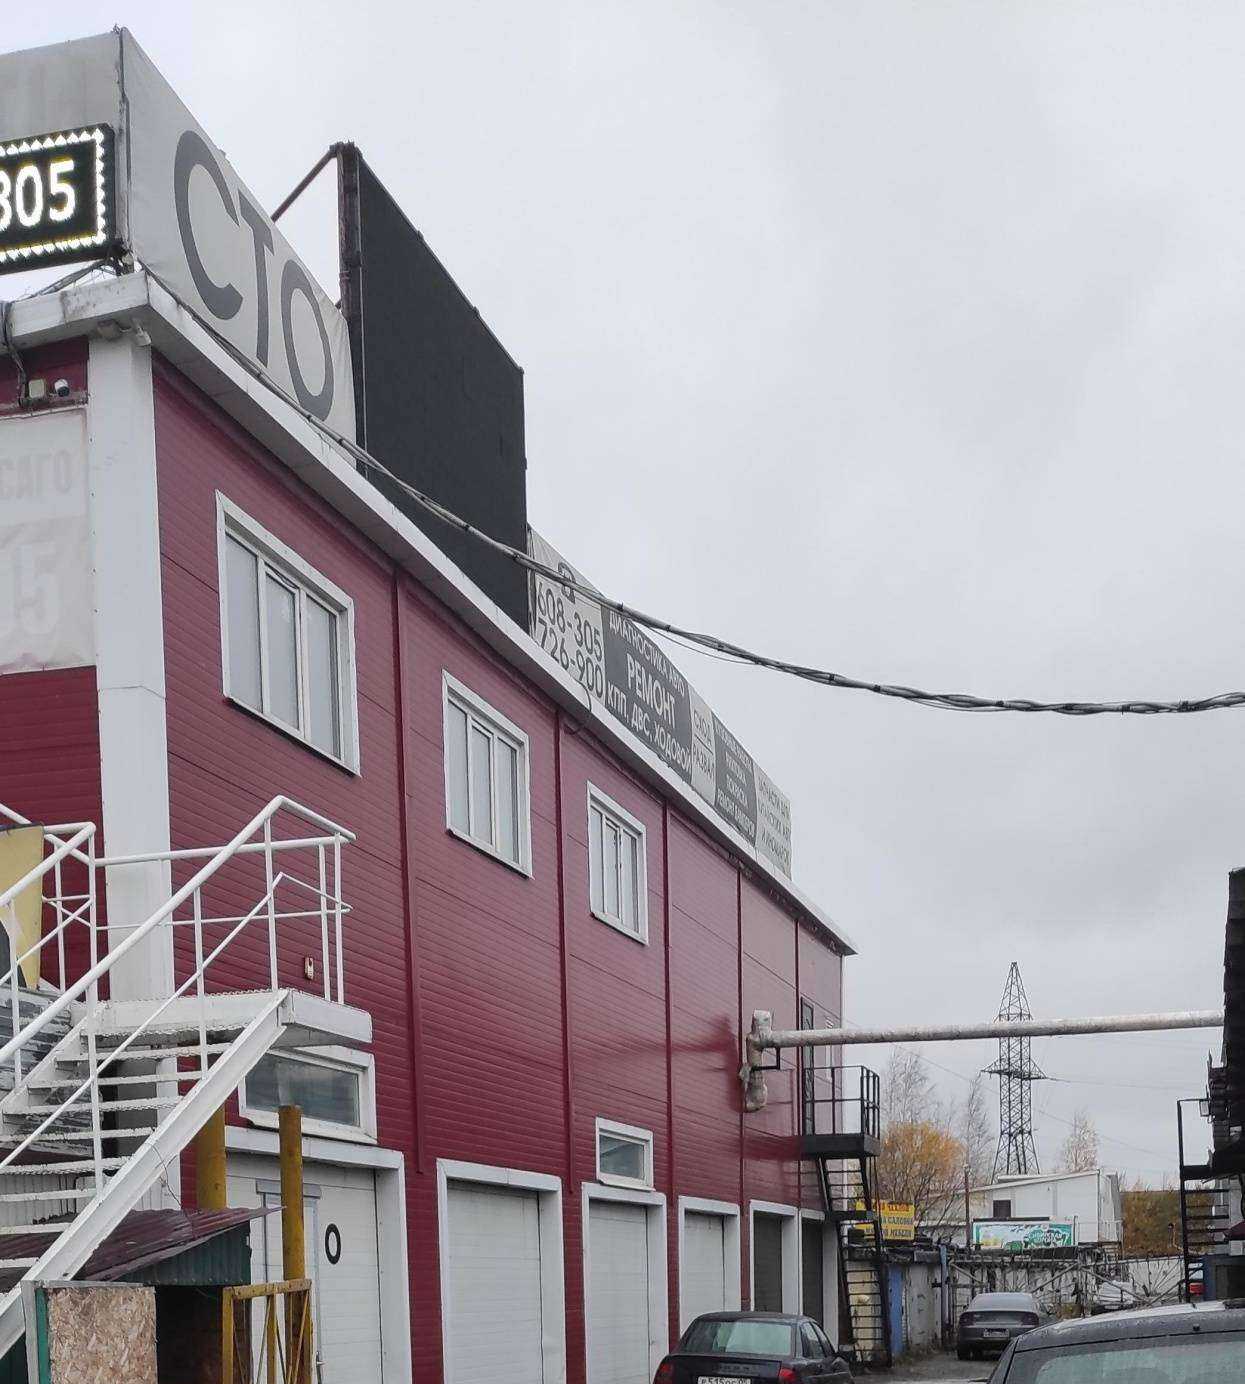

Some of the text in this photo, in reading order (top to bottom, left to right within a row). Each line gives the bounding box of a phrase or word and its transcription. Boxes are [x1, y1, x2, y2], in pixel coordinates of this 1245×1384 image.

[174, 130, 334, 421] СТО
[537, 581, 602, 662] 608-305
[538, 617, 604, 698] 726-900
[626, 652, 676, 729] РЕМОНТ
[654, 720, 691, 772] ХОДОВОЙ
